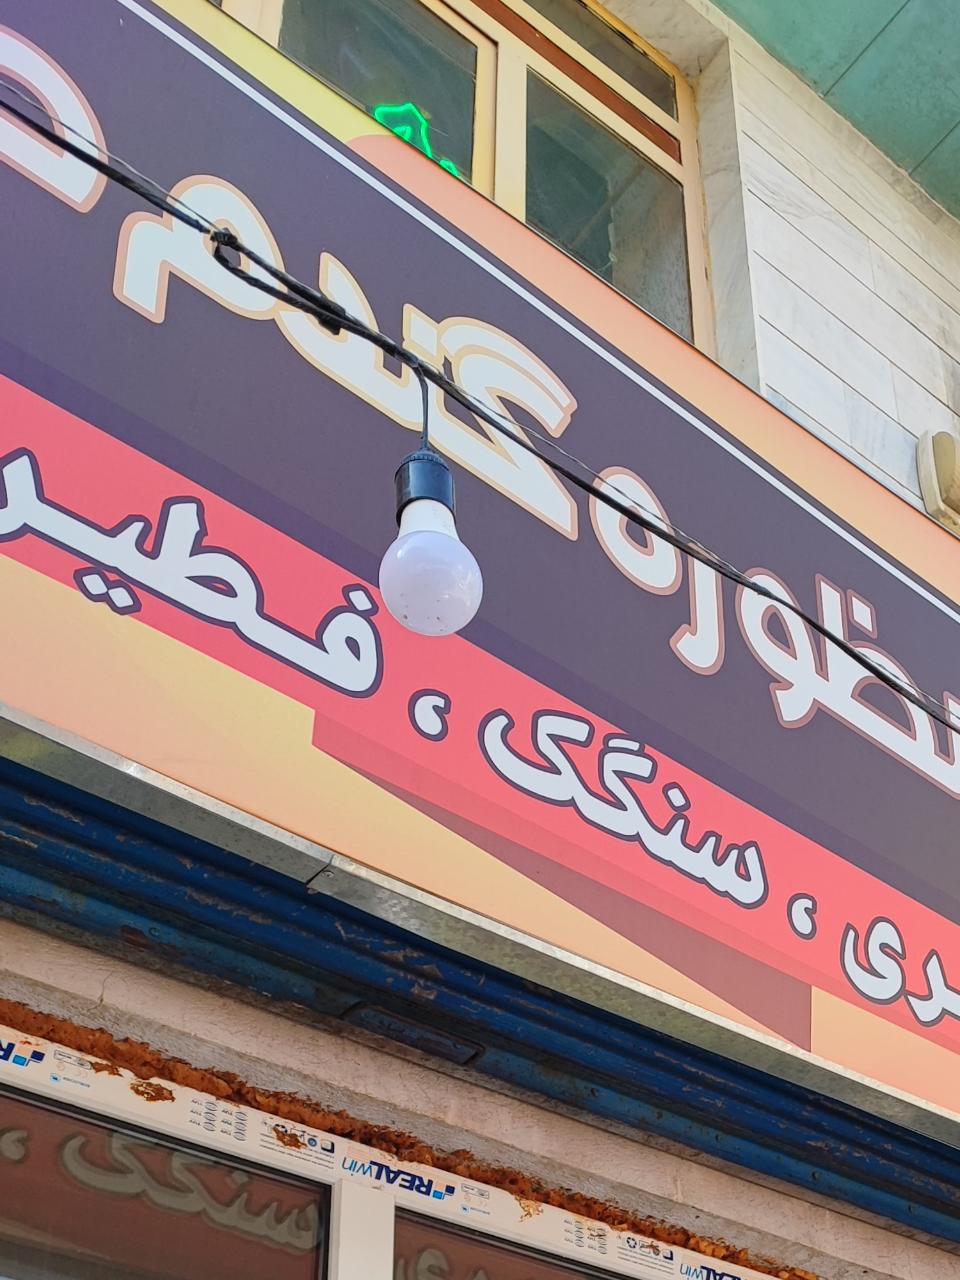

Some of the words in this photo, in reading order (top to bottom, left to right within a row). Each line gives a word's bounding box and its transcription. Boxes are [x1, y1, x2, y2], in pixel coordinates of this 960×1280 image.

[113, 174, 577, 541] گندم
[0, 447, 382, 693] فطیر
[478, 708, 769, 907] سنگکی
[341, 1155, 434, 1198] REALwin
